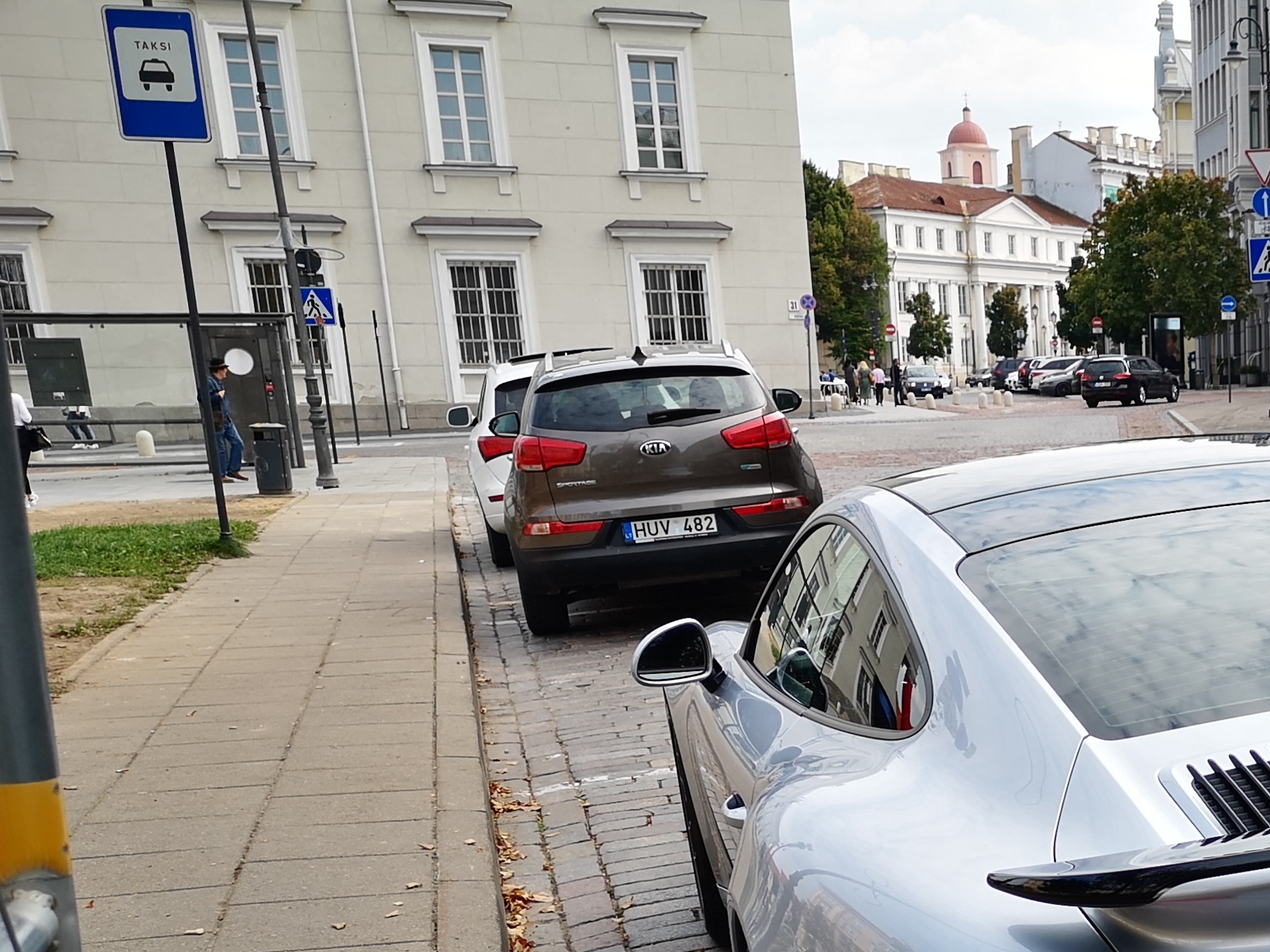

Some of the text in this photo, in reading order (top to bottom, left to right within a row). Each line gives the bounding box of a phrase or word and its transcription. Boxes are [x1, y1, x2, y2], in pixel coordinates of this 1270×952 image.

[133, 40, 172, 51] TAKSI
[790, 301, 798, 310] 31
[645, 443, 667, 454] KIA
[633, 519, 670, 538] HUV
[683, 516, 715, 532] 482
